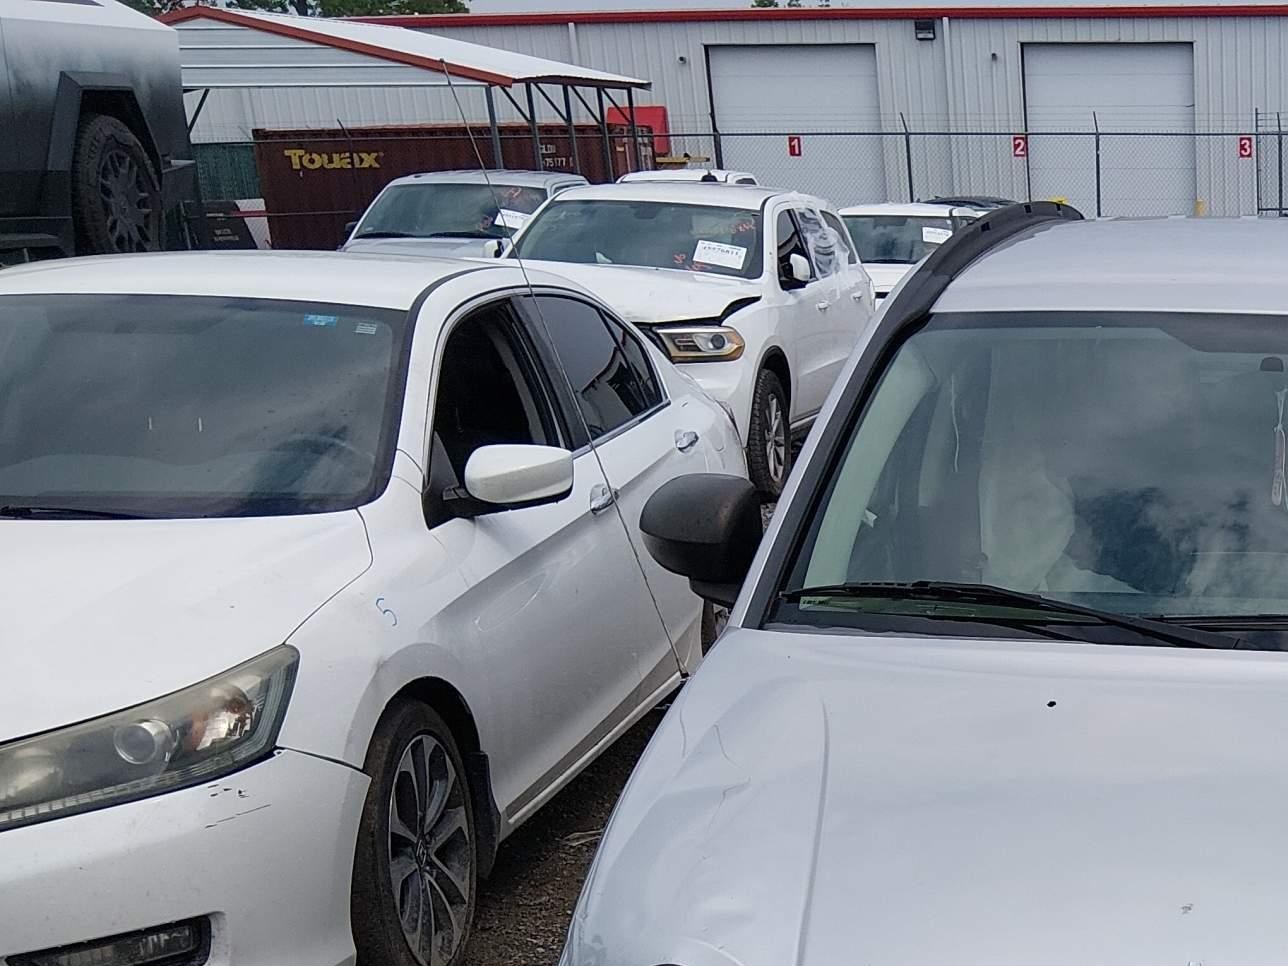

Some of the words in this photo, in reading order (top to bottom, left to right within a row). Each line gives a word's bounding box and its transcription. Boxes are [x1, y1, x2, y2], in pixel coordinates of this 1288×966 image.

[790, 138, 799, 154] 1
[1014, 139, 1025, 155] 2
[1240, 139, 1251, 155] 3
